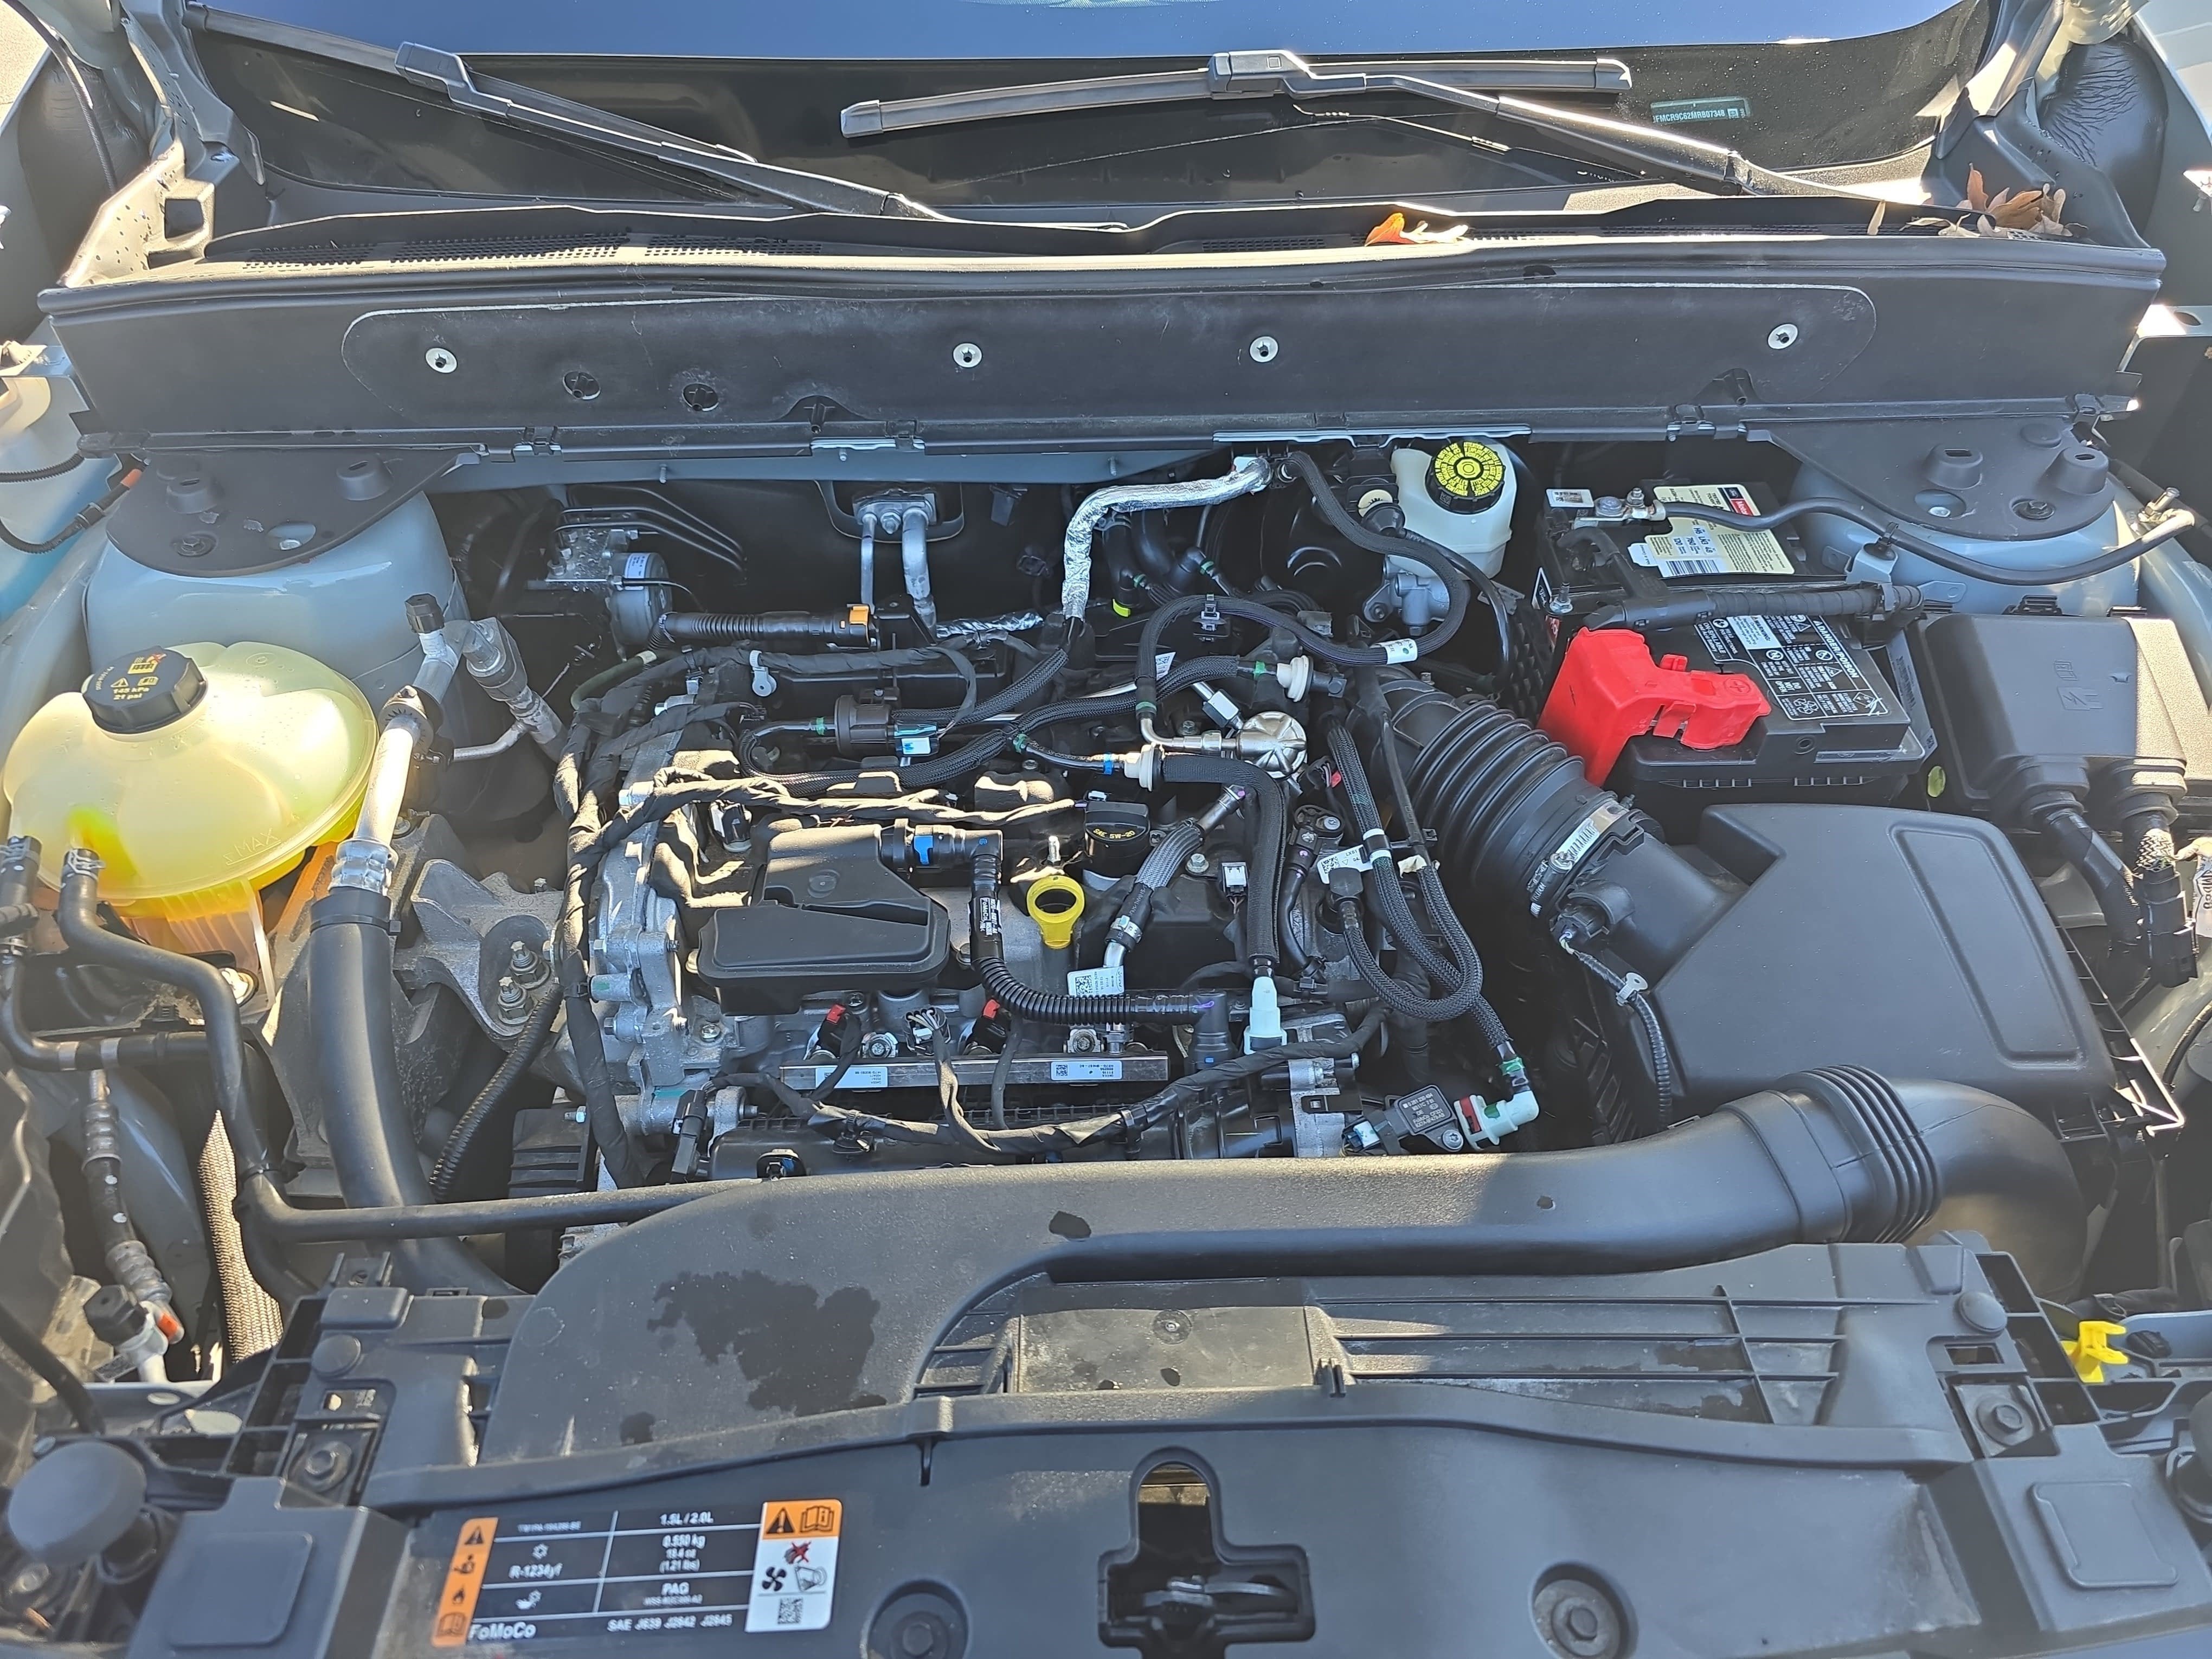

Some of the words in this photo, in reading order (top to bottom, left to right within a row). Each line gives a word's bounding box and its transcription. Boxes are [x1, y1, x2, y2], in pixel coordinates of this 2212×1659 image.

[1816, 626, 1860, 678] DANGER/POISON
[1783, 682, 1795, 691] NOT
[1093, 828, 1108, 837] SAE
[1109, 830, 1136, 839] 5W-20
[689, 1511, 714, 1524] 2.0L
[508, 1562, 563, 1579] R-1234yf
[661, 1581, 690, 1596] PAG
[468, 1622, 536, 1640] FoMoCo
[607, 1618, 633, 1632] SAE
